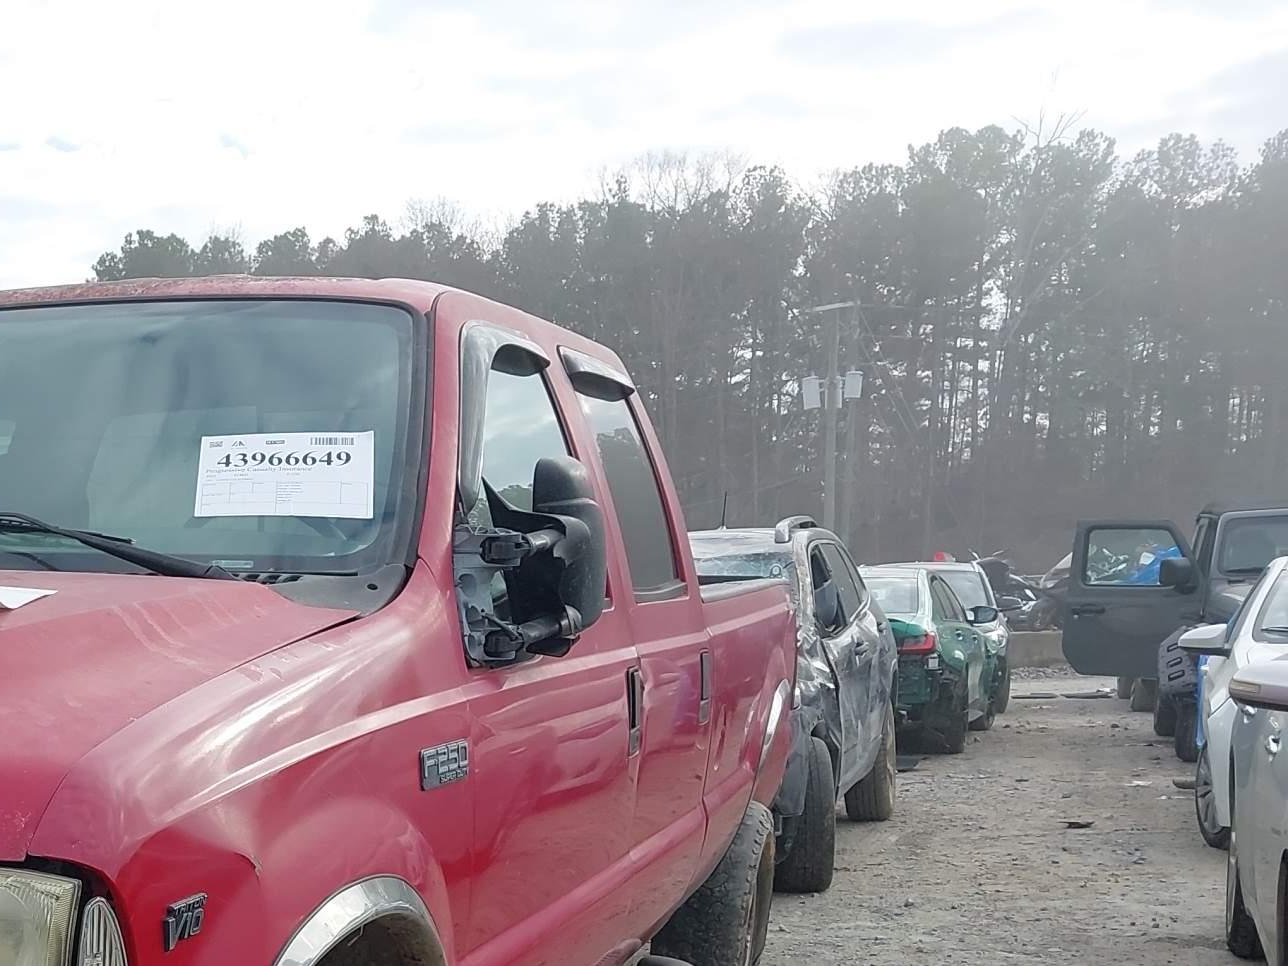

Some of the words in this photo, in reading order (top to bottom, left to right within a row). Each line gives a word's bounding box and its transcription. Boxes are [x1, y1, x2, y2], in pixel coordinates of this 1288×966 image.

[217, 451, 352, 468] 43966649
[423, 742, 469, 778] F250
[165, 908, 204, 951] V10
